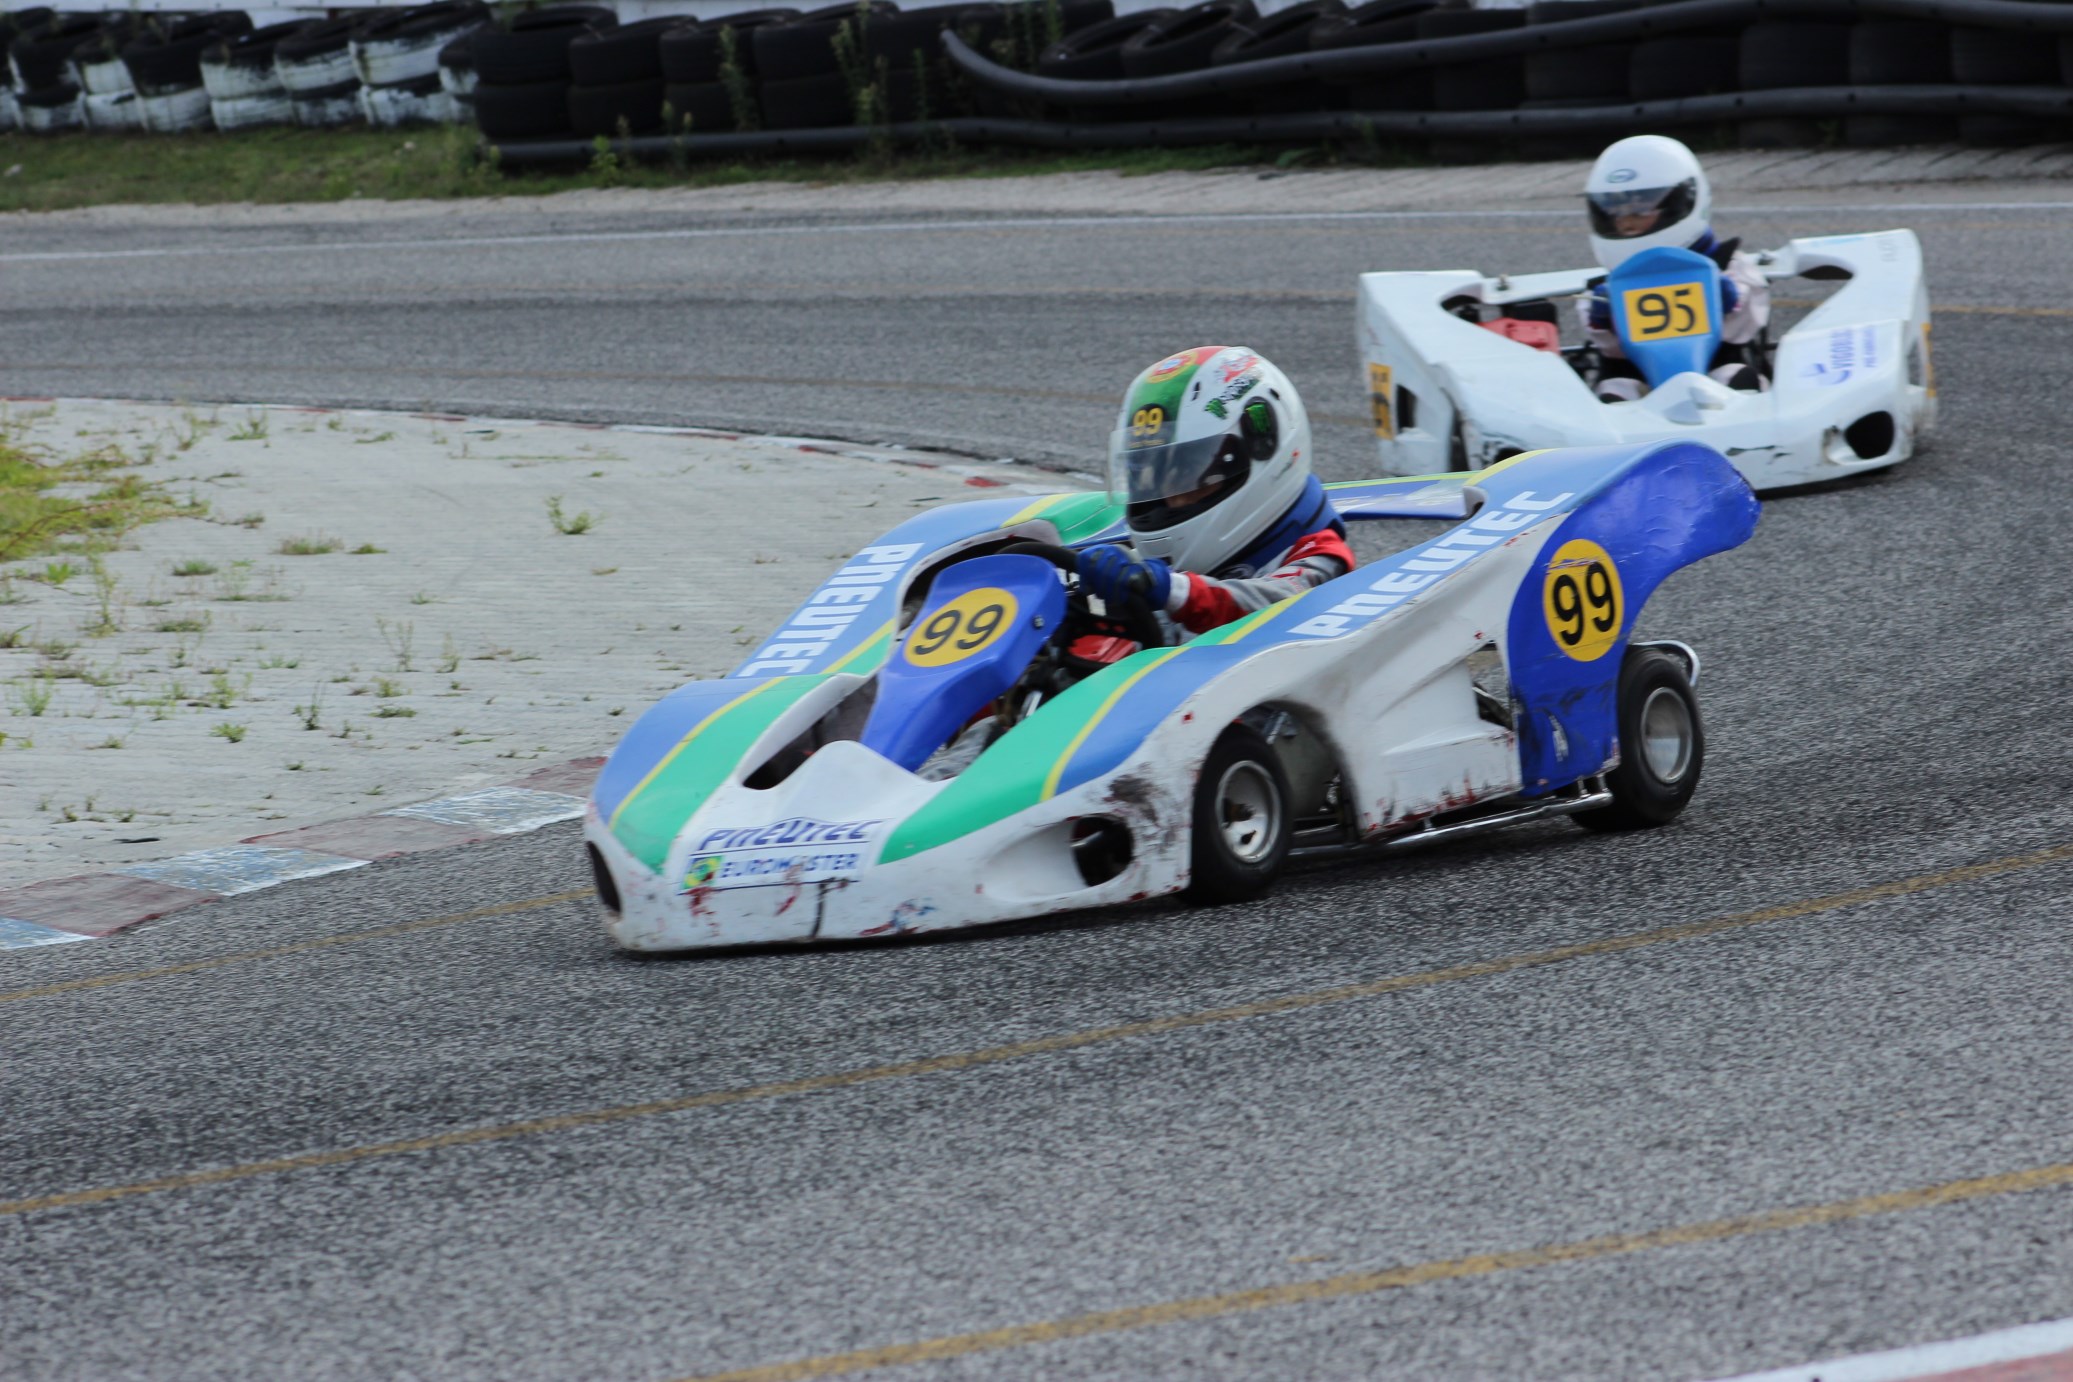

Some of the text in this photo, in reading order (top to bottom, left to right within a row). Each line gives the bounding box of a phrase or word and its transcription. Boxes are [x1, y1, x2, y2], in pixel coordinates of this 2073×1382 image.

[1636, 287, 1696, 335] 95
[1132, 406, 1164, 437] 99
[1286, 490, 1577, 637] PNEUTEC
[736, 542, 925, 677] PNEUTEC
[914, 603, 1005, 655] 99
[1552, 561, 1616, 646] 99
